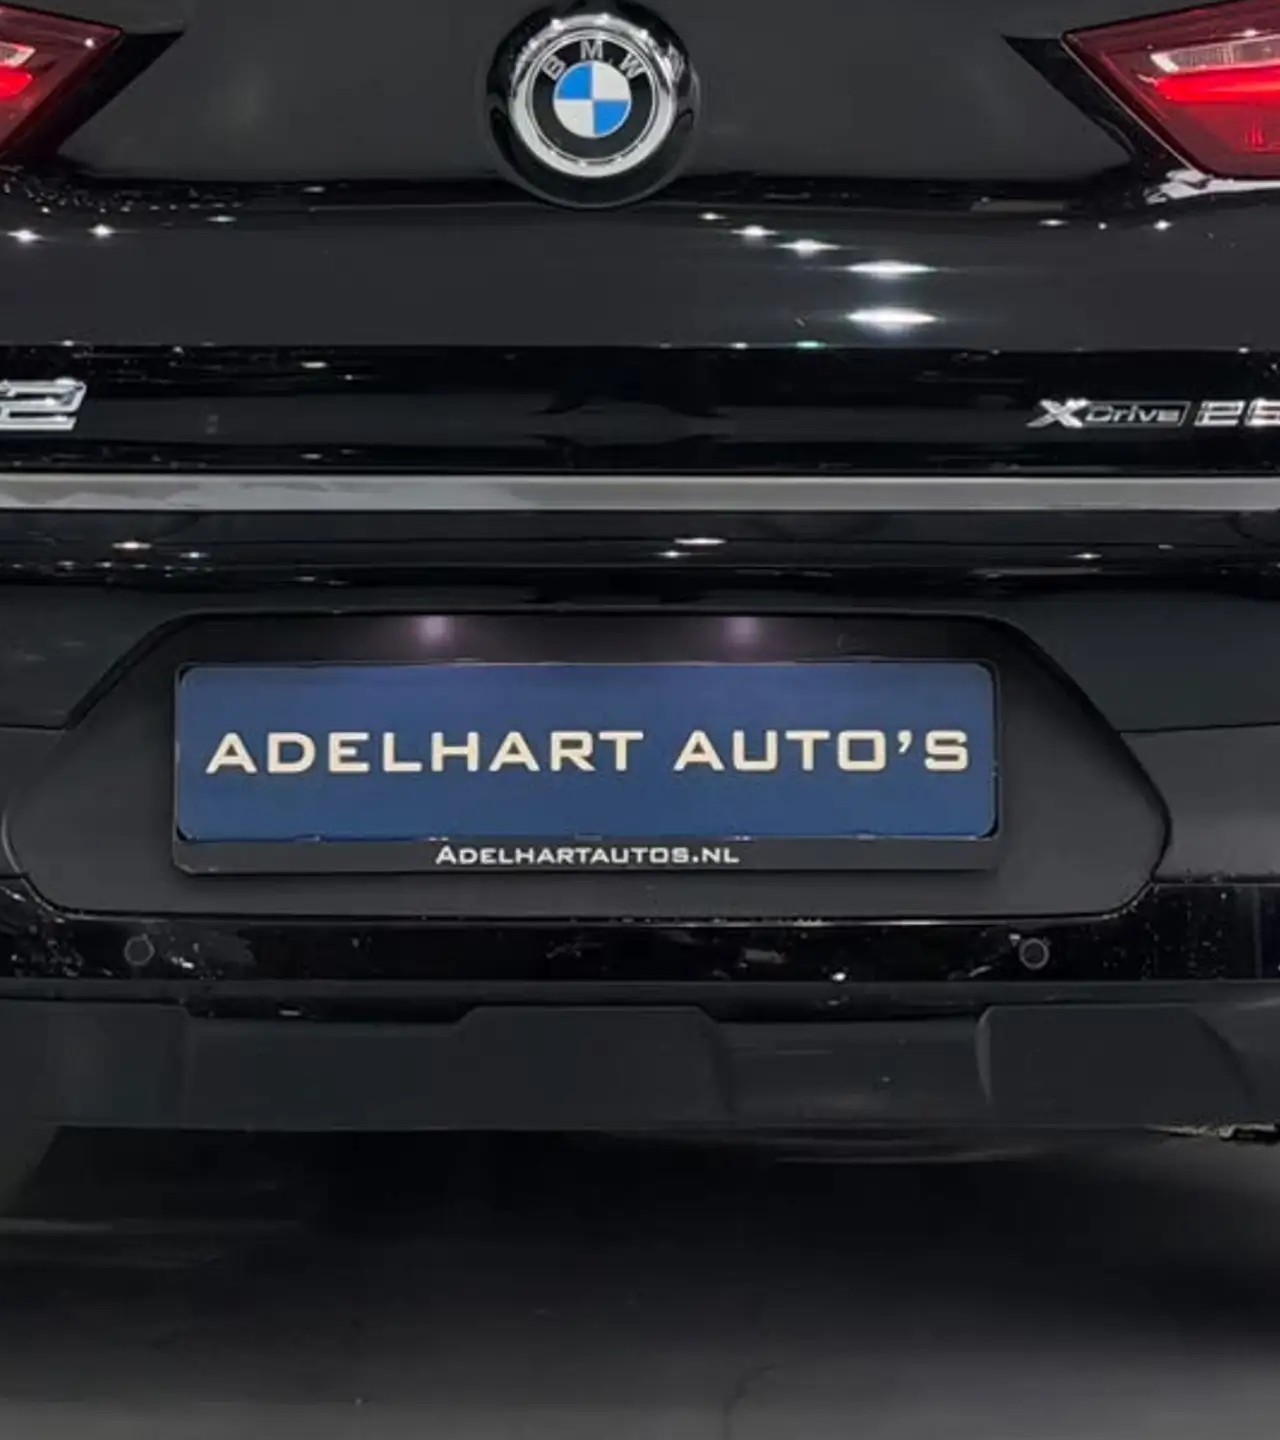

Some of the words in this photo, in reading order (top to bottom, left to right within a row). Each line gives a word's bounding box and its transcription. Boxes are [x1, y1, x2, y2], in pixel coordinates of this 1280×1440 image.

[542, 38, 647, 81] BMW
[205, 730, 645, 775] ADELHART
[672, 728, 971, 773] AUTO'S
